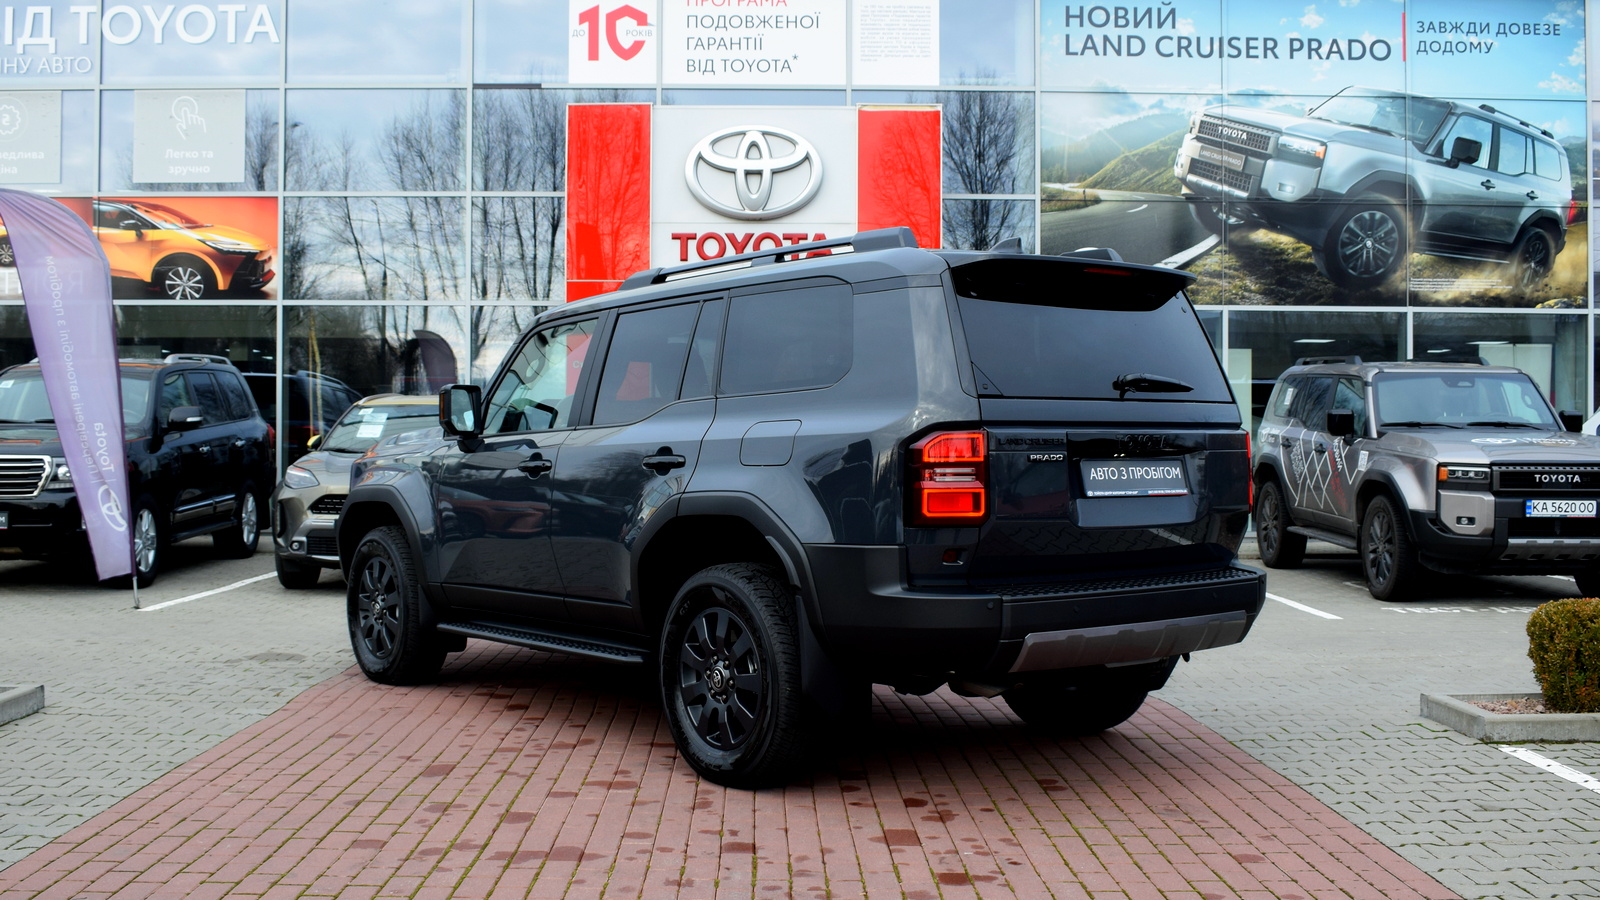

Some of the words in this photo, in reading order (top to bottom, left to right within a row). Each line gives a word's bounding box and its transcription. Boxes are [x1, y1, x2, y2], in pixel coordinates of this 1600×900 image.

[686, 12, 820, 31] ПОДОВЖЕНОЇ
[1065, 1, 1176, 29] НОВИЙ
[70, 4, 281, 45] TOYOTA
[1416, 21, 1490, 37] ЗАВЖДИ
[1496, 22, 1561, 38] ДОВЕЗЕ
[572, 29, 586, 38] ДО
[625, 29, 653, 37] РОКІВ
[686, 34, 764, 51] ГАРАНТІЇ
[1065, 33, 1146, 58] LAND
[1155, 35, 1279, 60] CRUISER
[1289, 37, 1392, 62] PRADO
[1416, 40, 1494, 56] ДОДОМУ
[0, 57, 32, 74] НУ
[37, 56, 93, 74] АВТО
[686, 59, 716, 75] ВІД
[1218, 127, 1248, 140] TOYOTA
[164, 148, 199, 159] Легко
[200, 150, 214, 159] та
[167, 165, 211, 176] зручно
[671, 231, 833, 262] TOYOTA
[999, 438, 1026, 447] LAND
[1090, 467, 1118, 480] АВТО
[1120, 467, 1127, 479] З
[1128, 466, 1182, 480] ПРОБІГОМ
[1534, 474, 1581, 483] TOYOTA
[1532, 502, 1549, 513] KA
[1551, 502, 1577, 513] 5620
